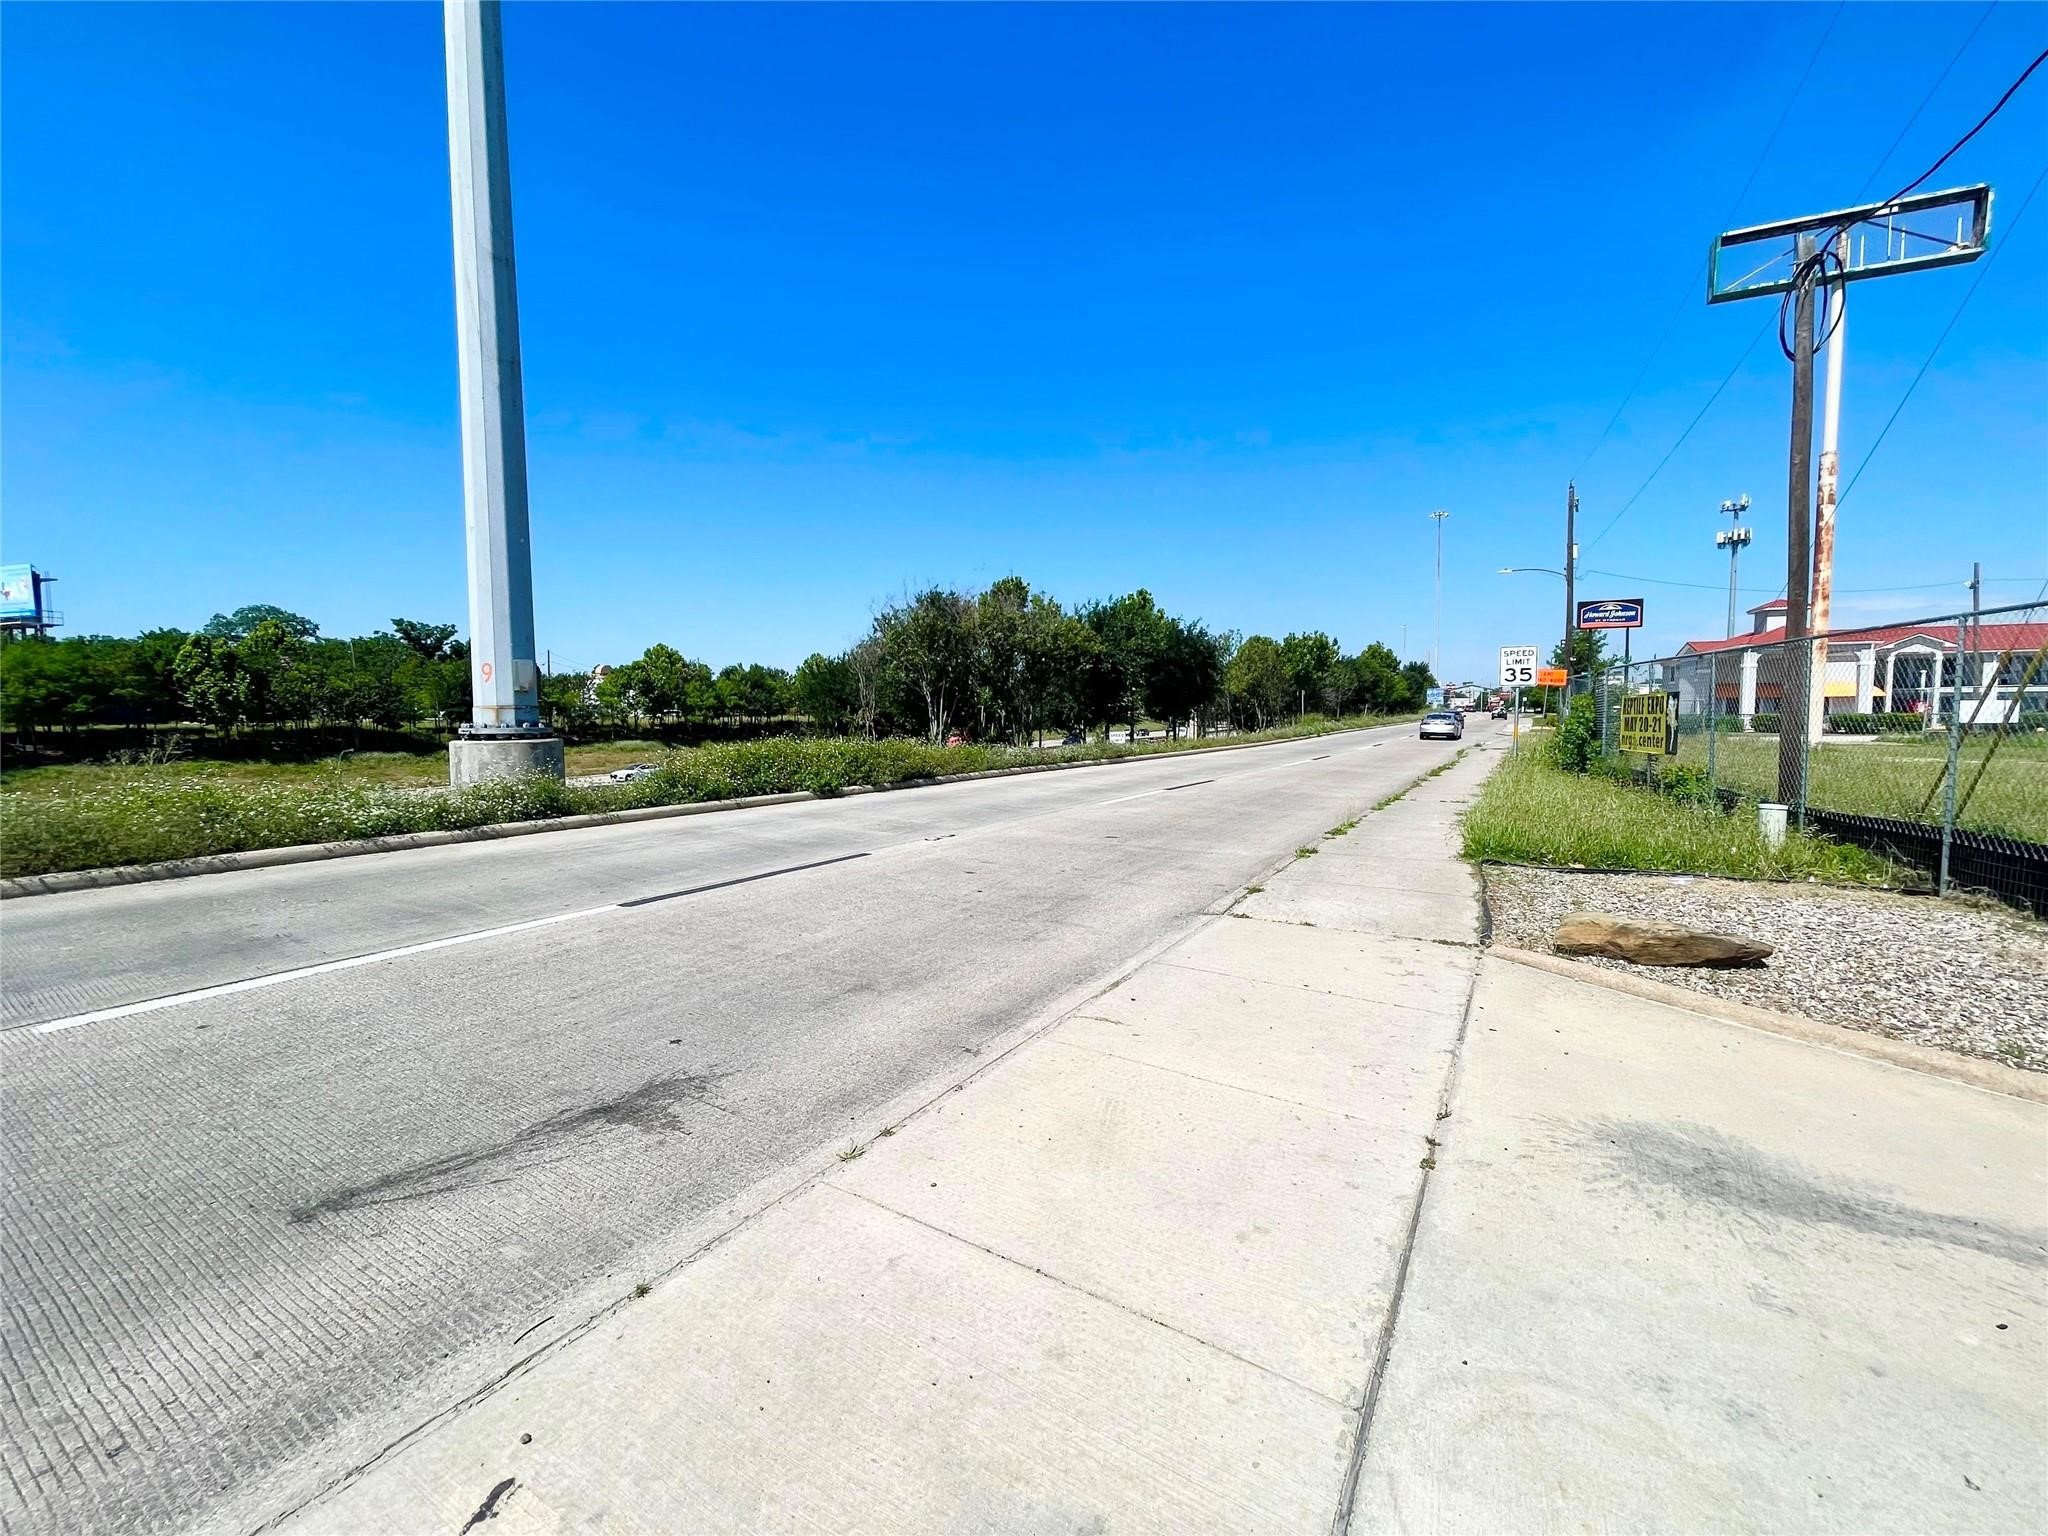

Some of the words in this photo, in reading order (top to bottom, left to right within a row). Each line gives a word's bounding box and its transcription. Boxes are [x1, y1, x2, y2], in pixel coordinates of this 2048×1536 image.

[1584, 611, 1610, 619] Howard
[1610, 610, 1637, 619] Johnson
[1503, 649, 1535, 657] SPEED
[1506, 658, 1531, 666] LIMIT
[481, 662, 492, 682] 9
[1504, 667, 1532, 682] 35
[1622, 696, 1645, 715] REPTILE
[1647, 695, 1664, 715] EXPO
[1623, 716, 1638, 732] MAY
[1639, 716, 1662, 733] 20-21
